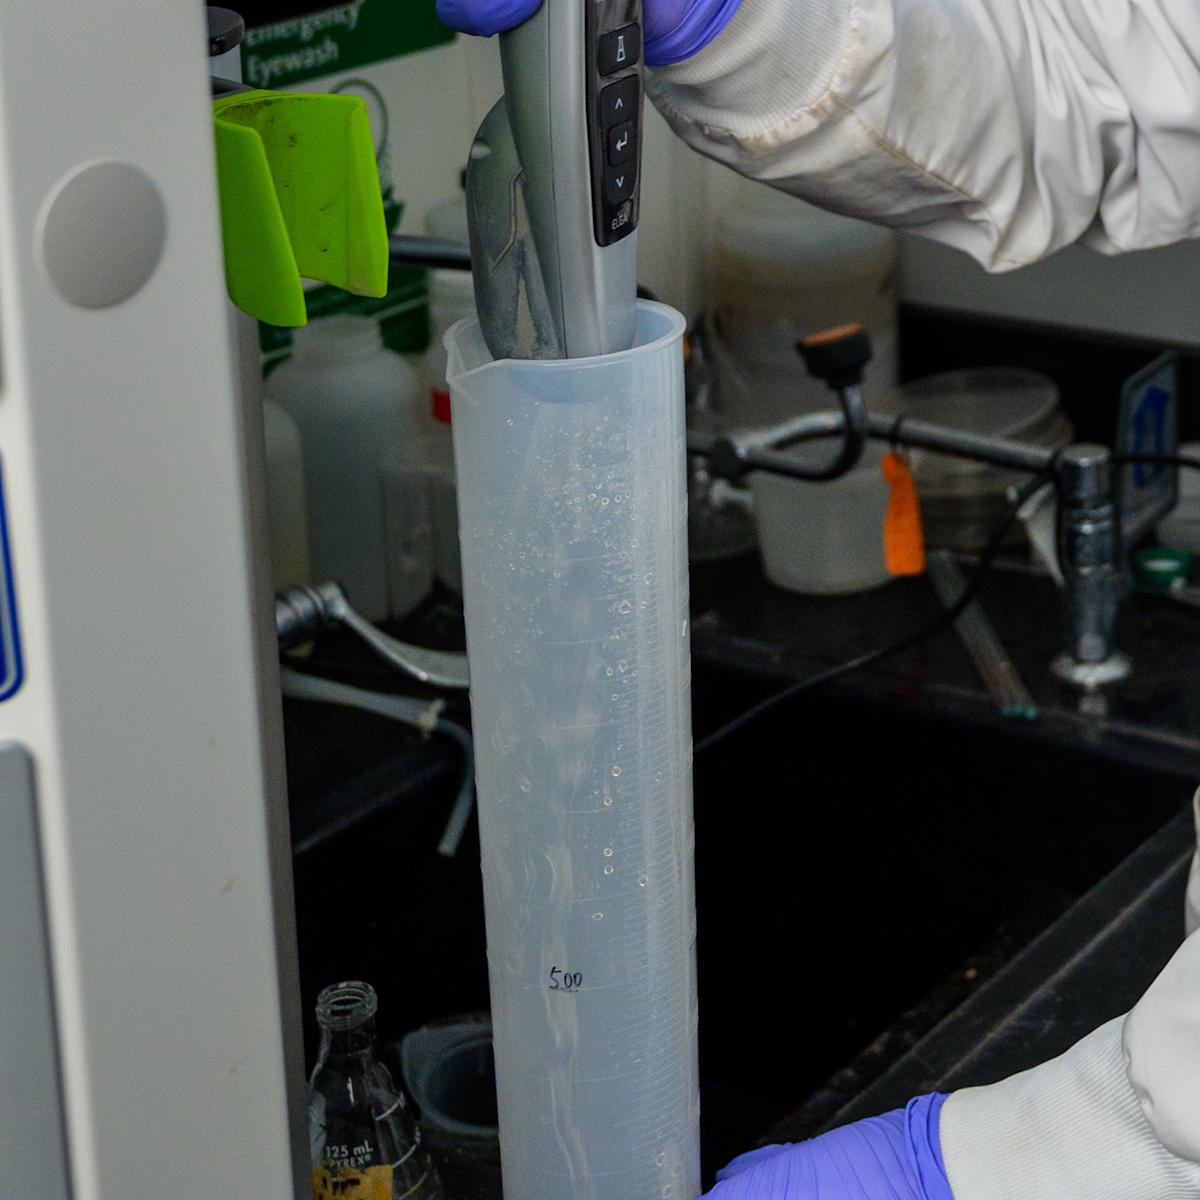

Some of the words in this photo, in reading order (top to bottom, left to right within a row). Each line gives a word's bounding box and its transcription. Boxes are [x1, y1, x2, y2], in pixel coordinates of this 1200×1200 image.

[612, 213, 628, 230] ELGA
[549, 966, 582, 990] 500
[326, 1145, 349, 1158] 125
[353, 1139, 373, 1156] mL
